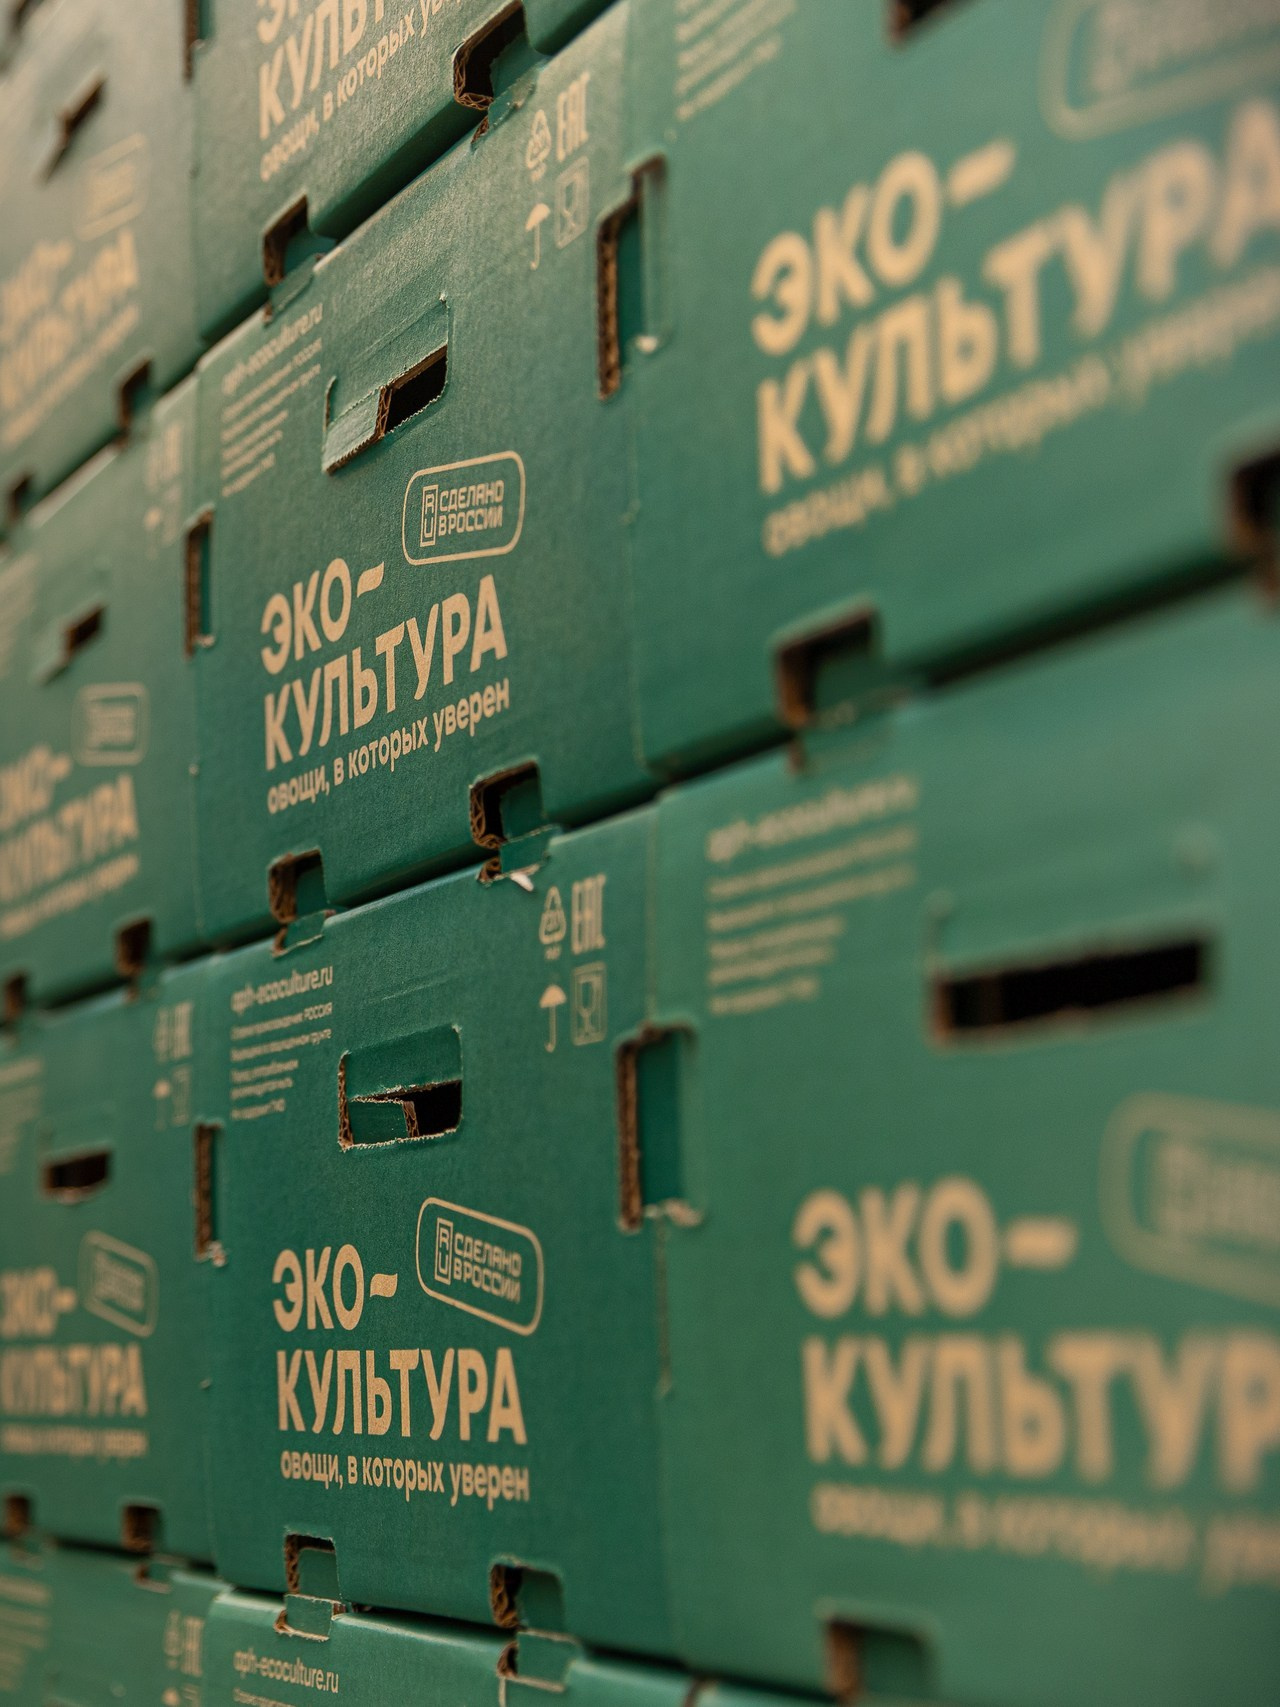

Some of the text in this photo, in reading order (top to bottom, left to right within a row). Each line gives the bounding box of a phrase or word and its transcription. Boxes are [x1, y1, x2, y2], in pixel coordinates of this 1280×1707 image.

[258, 0, 384, 141] КУЛЬ
[322, 90, 334, 123] в
[336, 8, 416, 109] которых
[750, 136, 1018, 357] ЭКО-
[439, 480, 504, 512] СДЕЛАНО
[260, 558, 384, 675] ЭКО-
[263, 574, 508, 771] КУЛЬТУРА
[267, 677, 510, 814] овощи, в которых уверен
[272, 1243, 398, 1332] ЭКО-
[454, 1232, 522, 1278] СДЕЛАНО
[792, 1175, 1078, 1319] ЭКО-
[276, 1347, 528, 1445] КУЛЬТУРА
[801, 1325, 1280, 1496] КУЛЬТУР
[280, 1450, 530, 1511] овощи, в которых уверен
